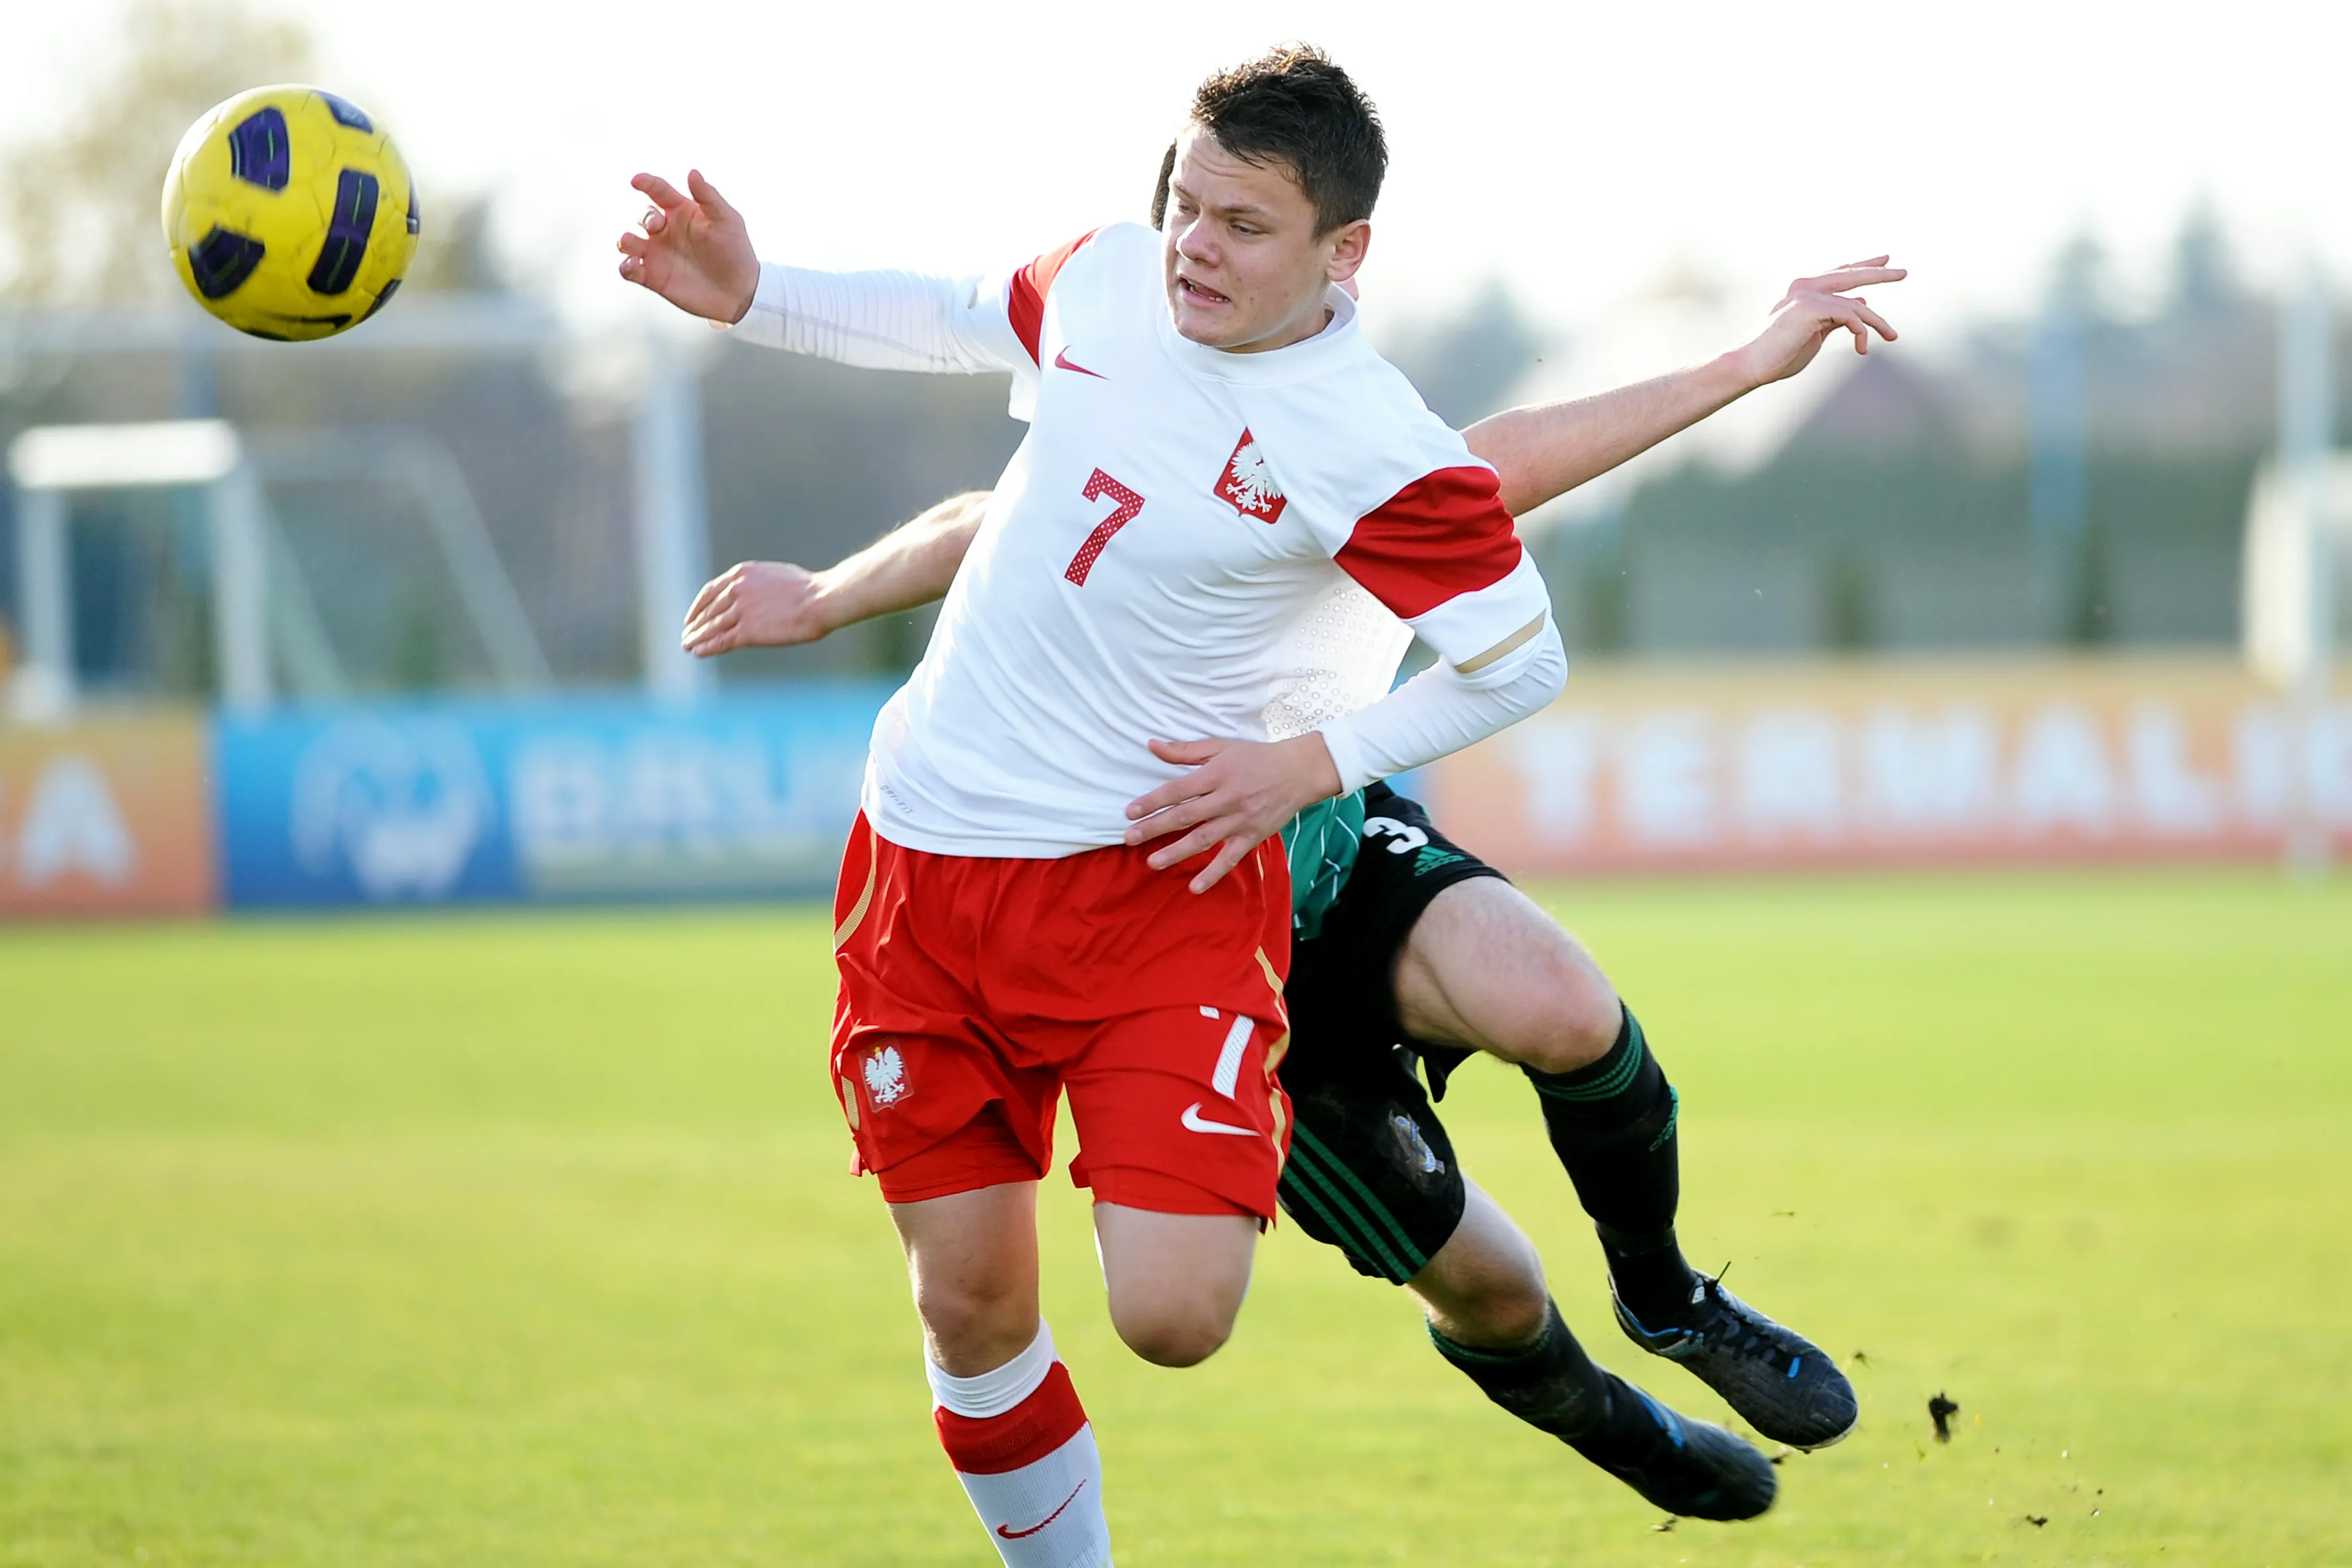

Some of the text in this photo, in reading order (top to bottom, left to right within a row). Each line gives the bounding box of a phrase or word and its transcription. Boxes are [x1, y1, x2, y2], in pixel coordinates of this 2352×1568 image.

[1064, 467, 1146, 588] 7
[880, 785, 914, 815] DRI-FIT
[1363, 816, 1429, 854] 3
